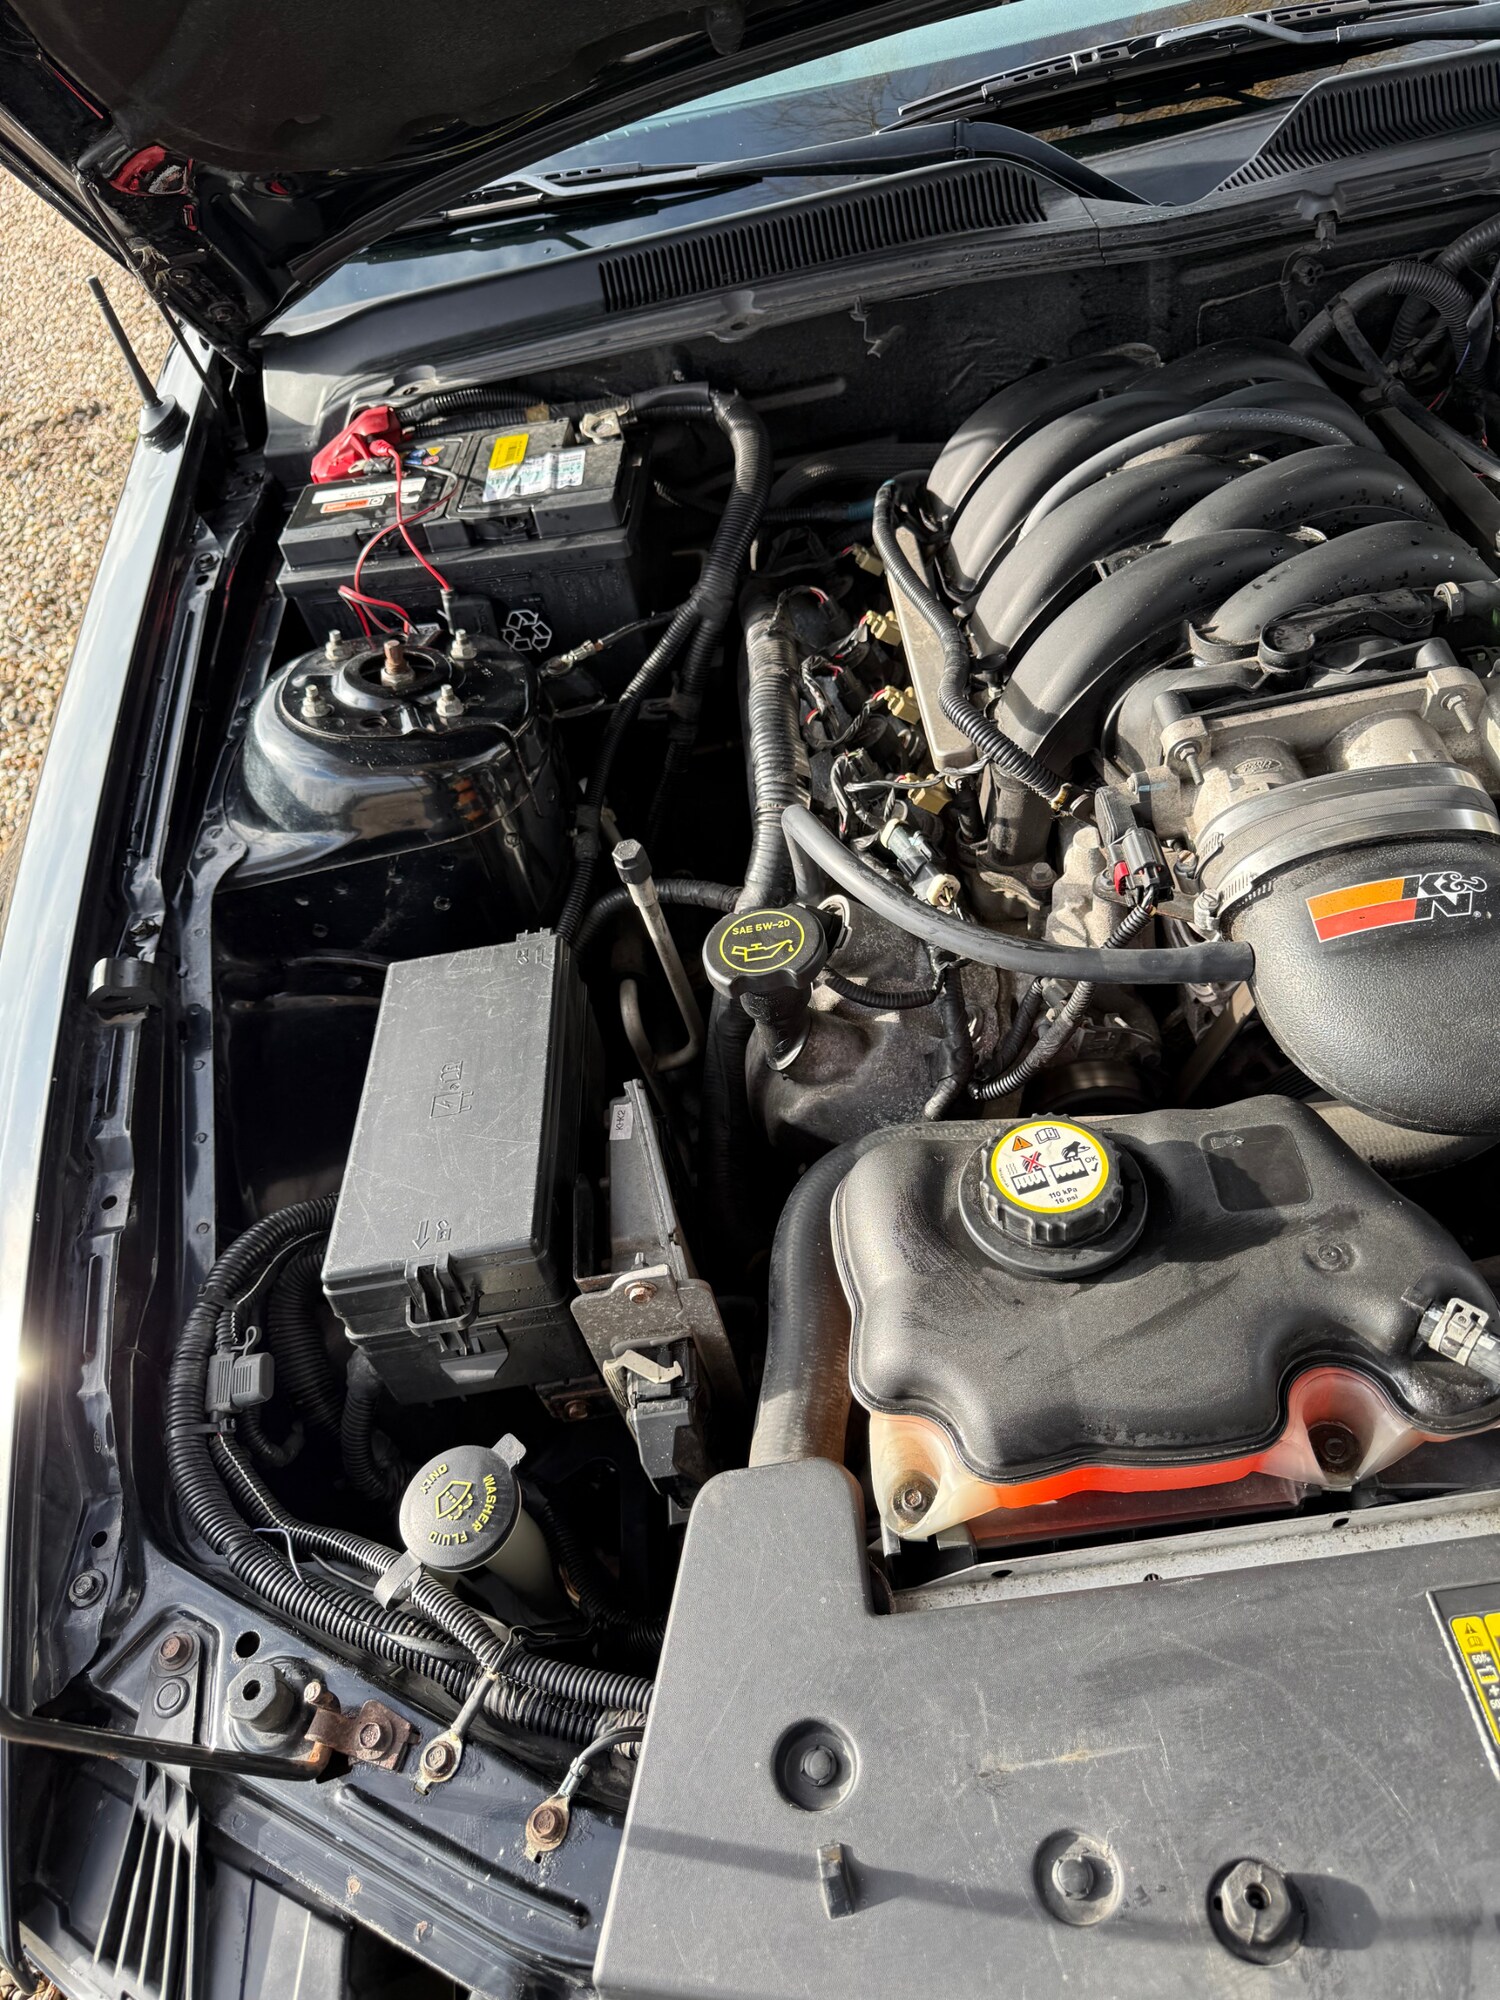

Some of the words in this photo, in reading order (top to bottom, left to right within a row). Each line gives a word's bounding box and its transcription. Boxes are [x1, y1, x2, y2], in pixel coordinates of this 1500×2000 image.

[731, 925, 754, 936] SAE
[755, 919, 791, 933] 5W-20
[615, 1109, 626, 1131] KHK2
[1084, 1155, 1099, 1164] OK
[1048, 1190, 1061, 1199] 110
[1062, 1187, 1078, 1196] kPa
[1054, 1197, 1065, 1205] 16
[1066, 1194, 1079, 1203] psi
[420, 1463, 448, 1495] ONLY
[472, 1473, 497, 1533] WASHER
[428, 1530, 468, 1546] FLUID
